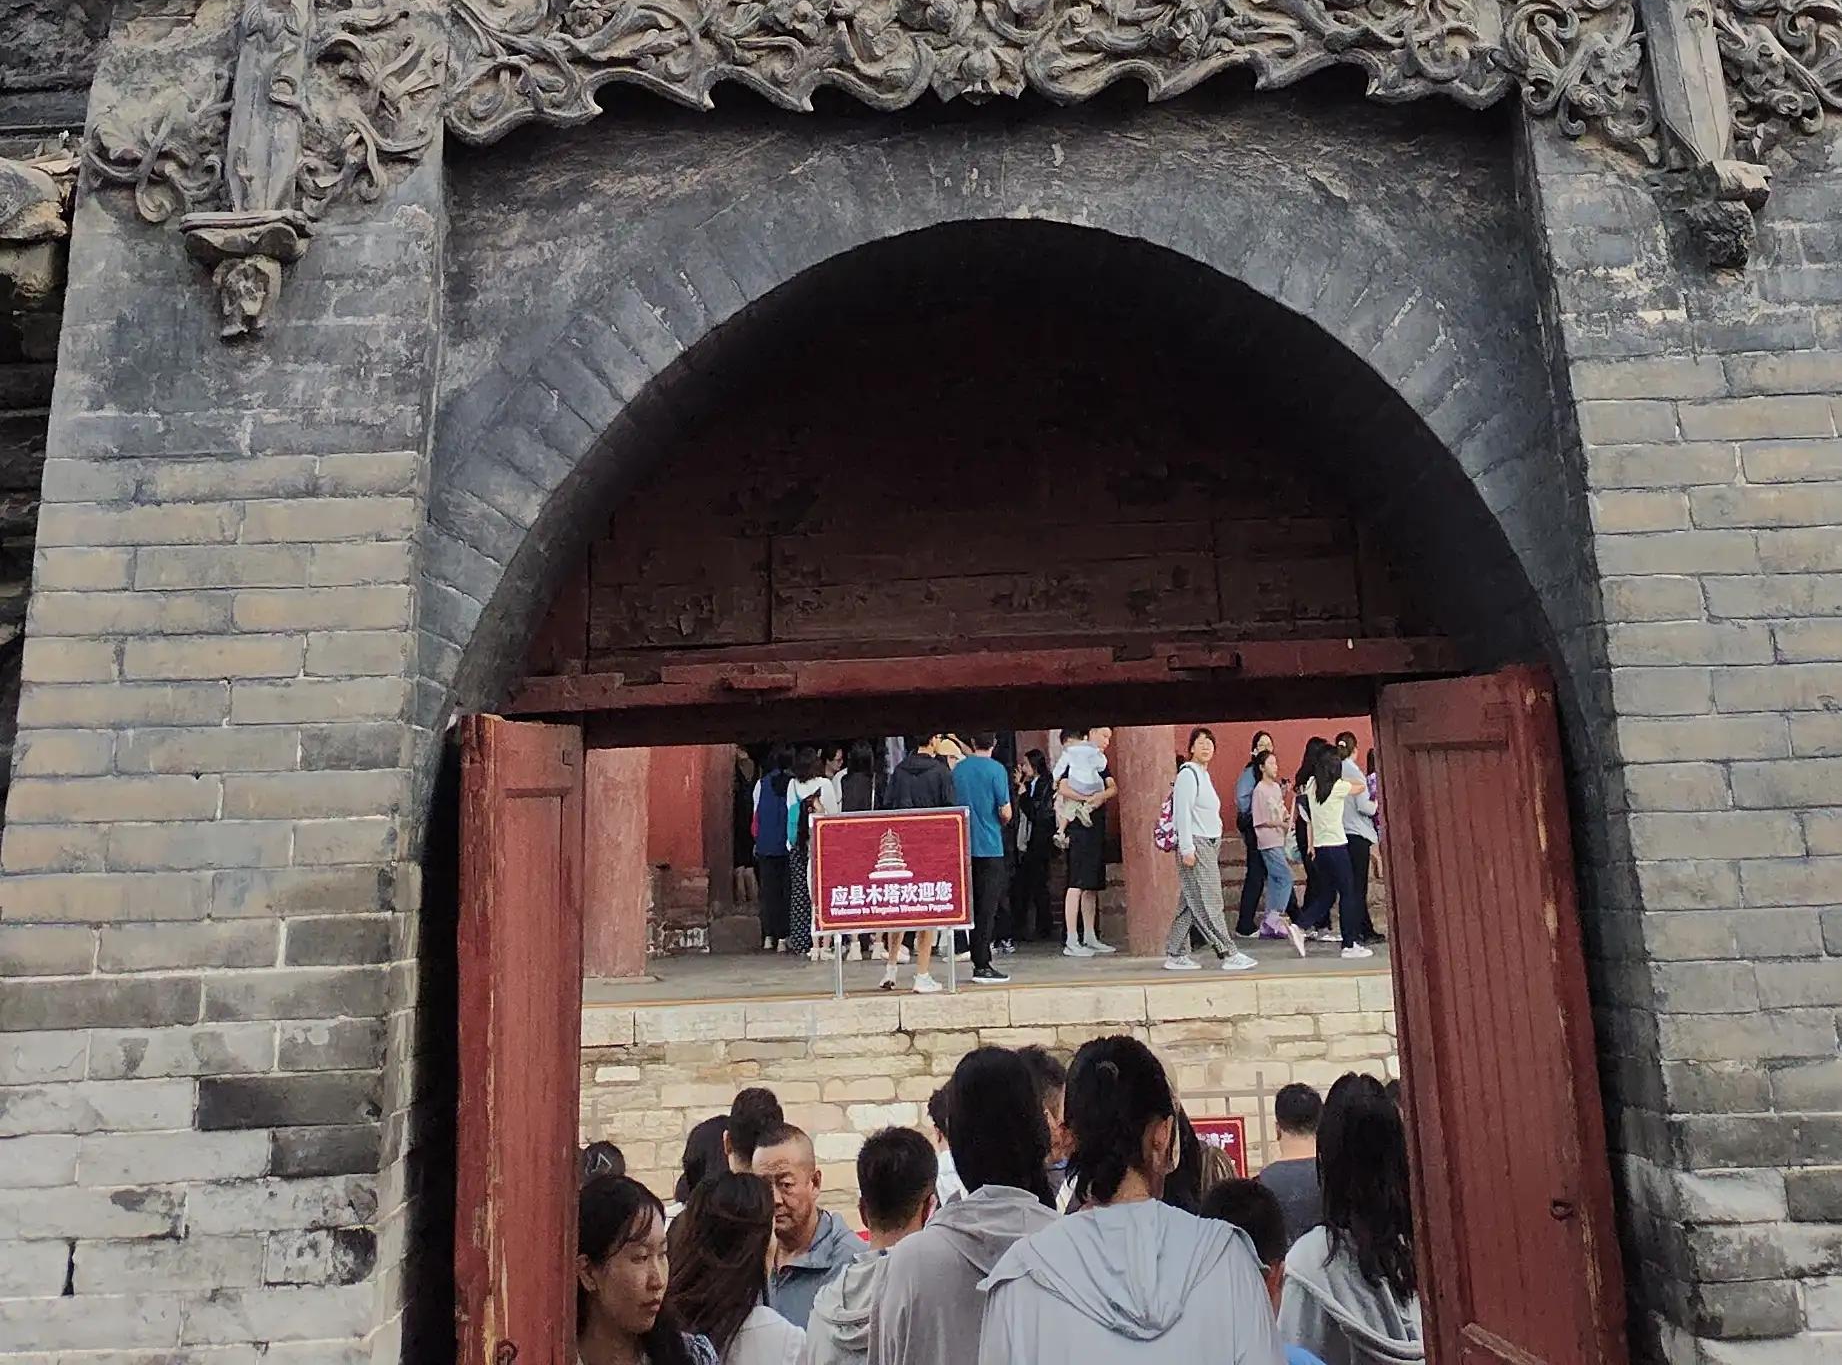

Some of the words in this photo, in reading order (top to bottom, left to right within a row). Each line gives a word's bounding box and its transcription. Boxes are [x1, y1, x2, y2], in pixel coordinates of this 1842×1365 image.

[830, 880, 953, 907] 应县木塔欢迎您
[830, 907, 862, 916] Welcome
[900, 904, 929, 914] Wooden
[929, 903, 954, 912] Pagoda
